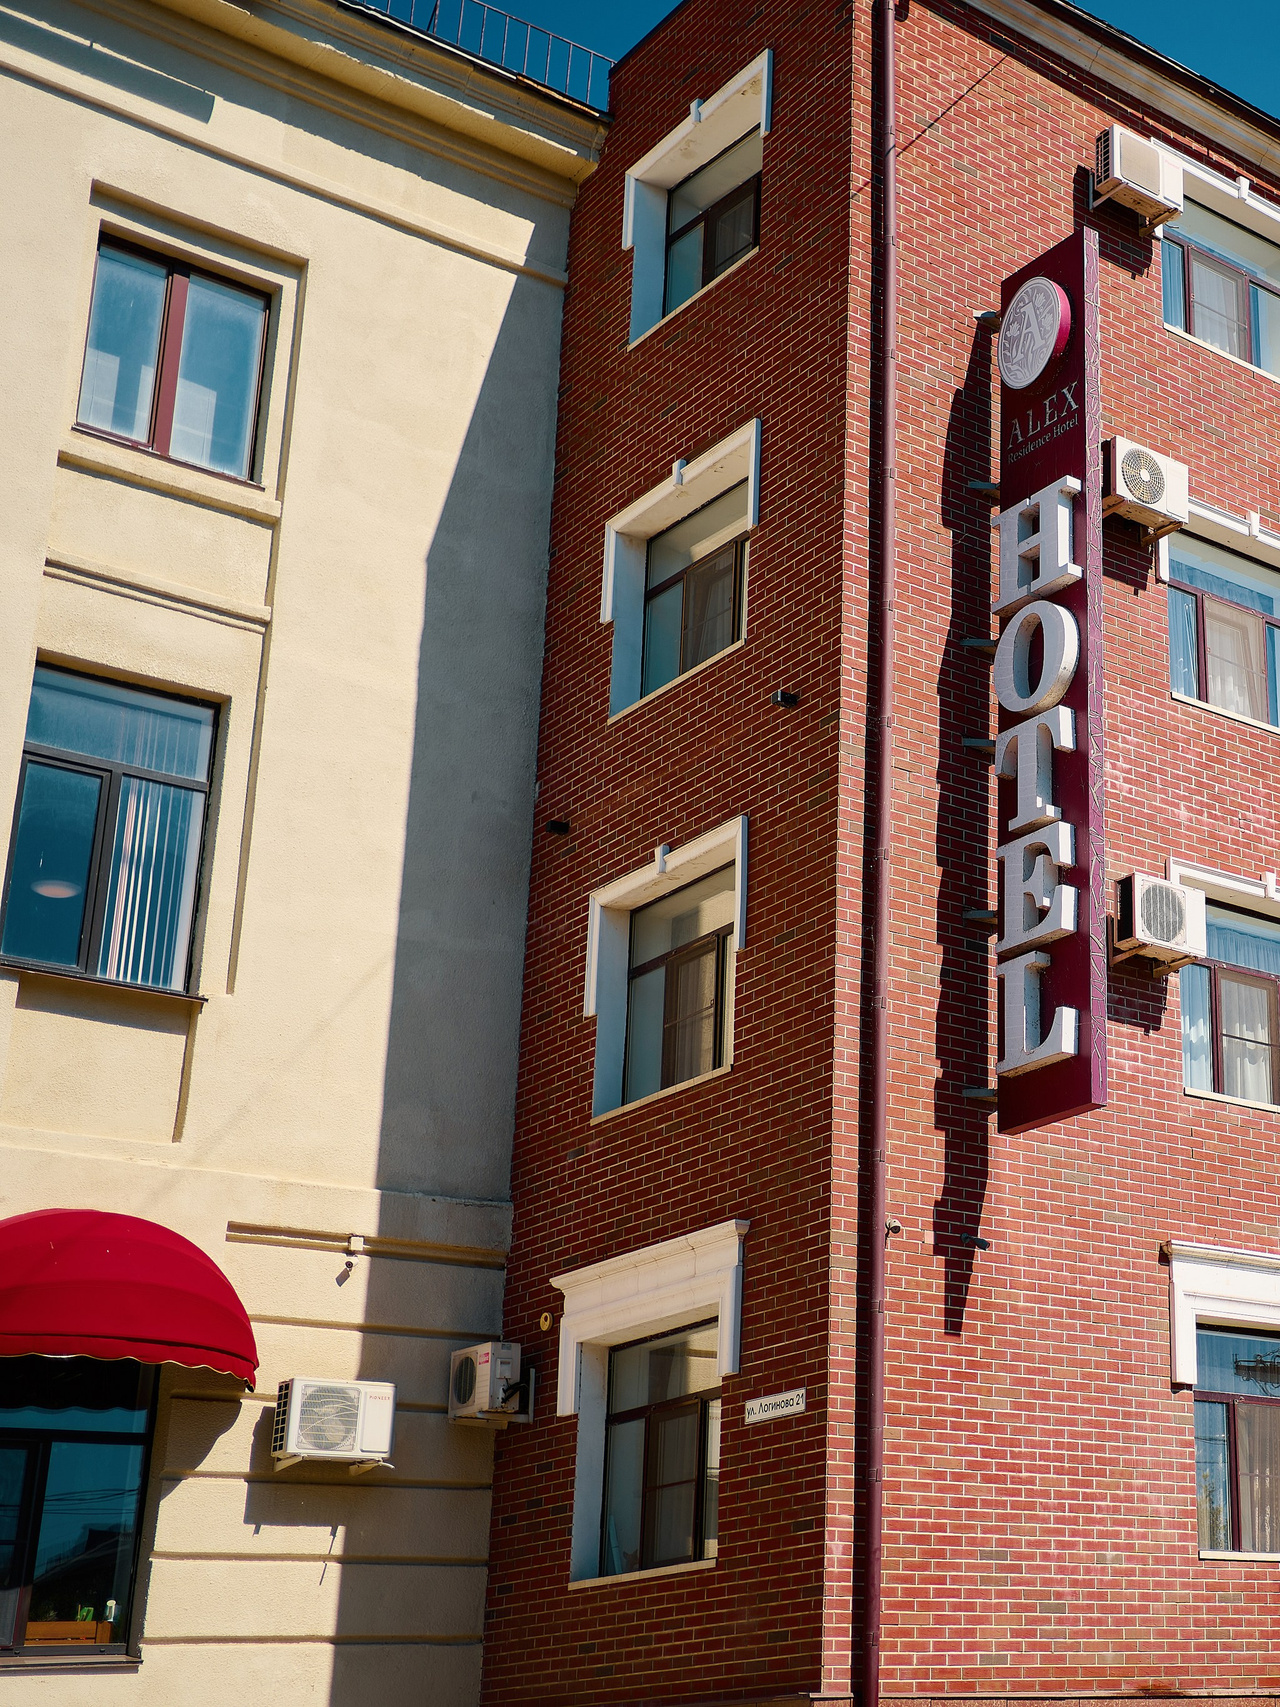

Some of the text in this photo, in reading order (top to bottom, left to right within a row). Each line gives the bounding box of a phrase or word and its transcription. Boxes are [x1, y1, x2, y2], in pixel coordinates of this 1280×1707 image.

[1012, 301, 1047, 363] A
[1007, 381, 1079, 450] ALEX
[1007, 413, 1079, 464] Residence Hotel
[992, 474, 1083, 1079] HOTEL
[746, 1393, 804, 1419] ул. Логинова 21
